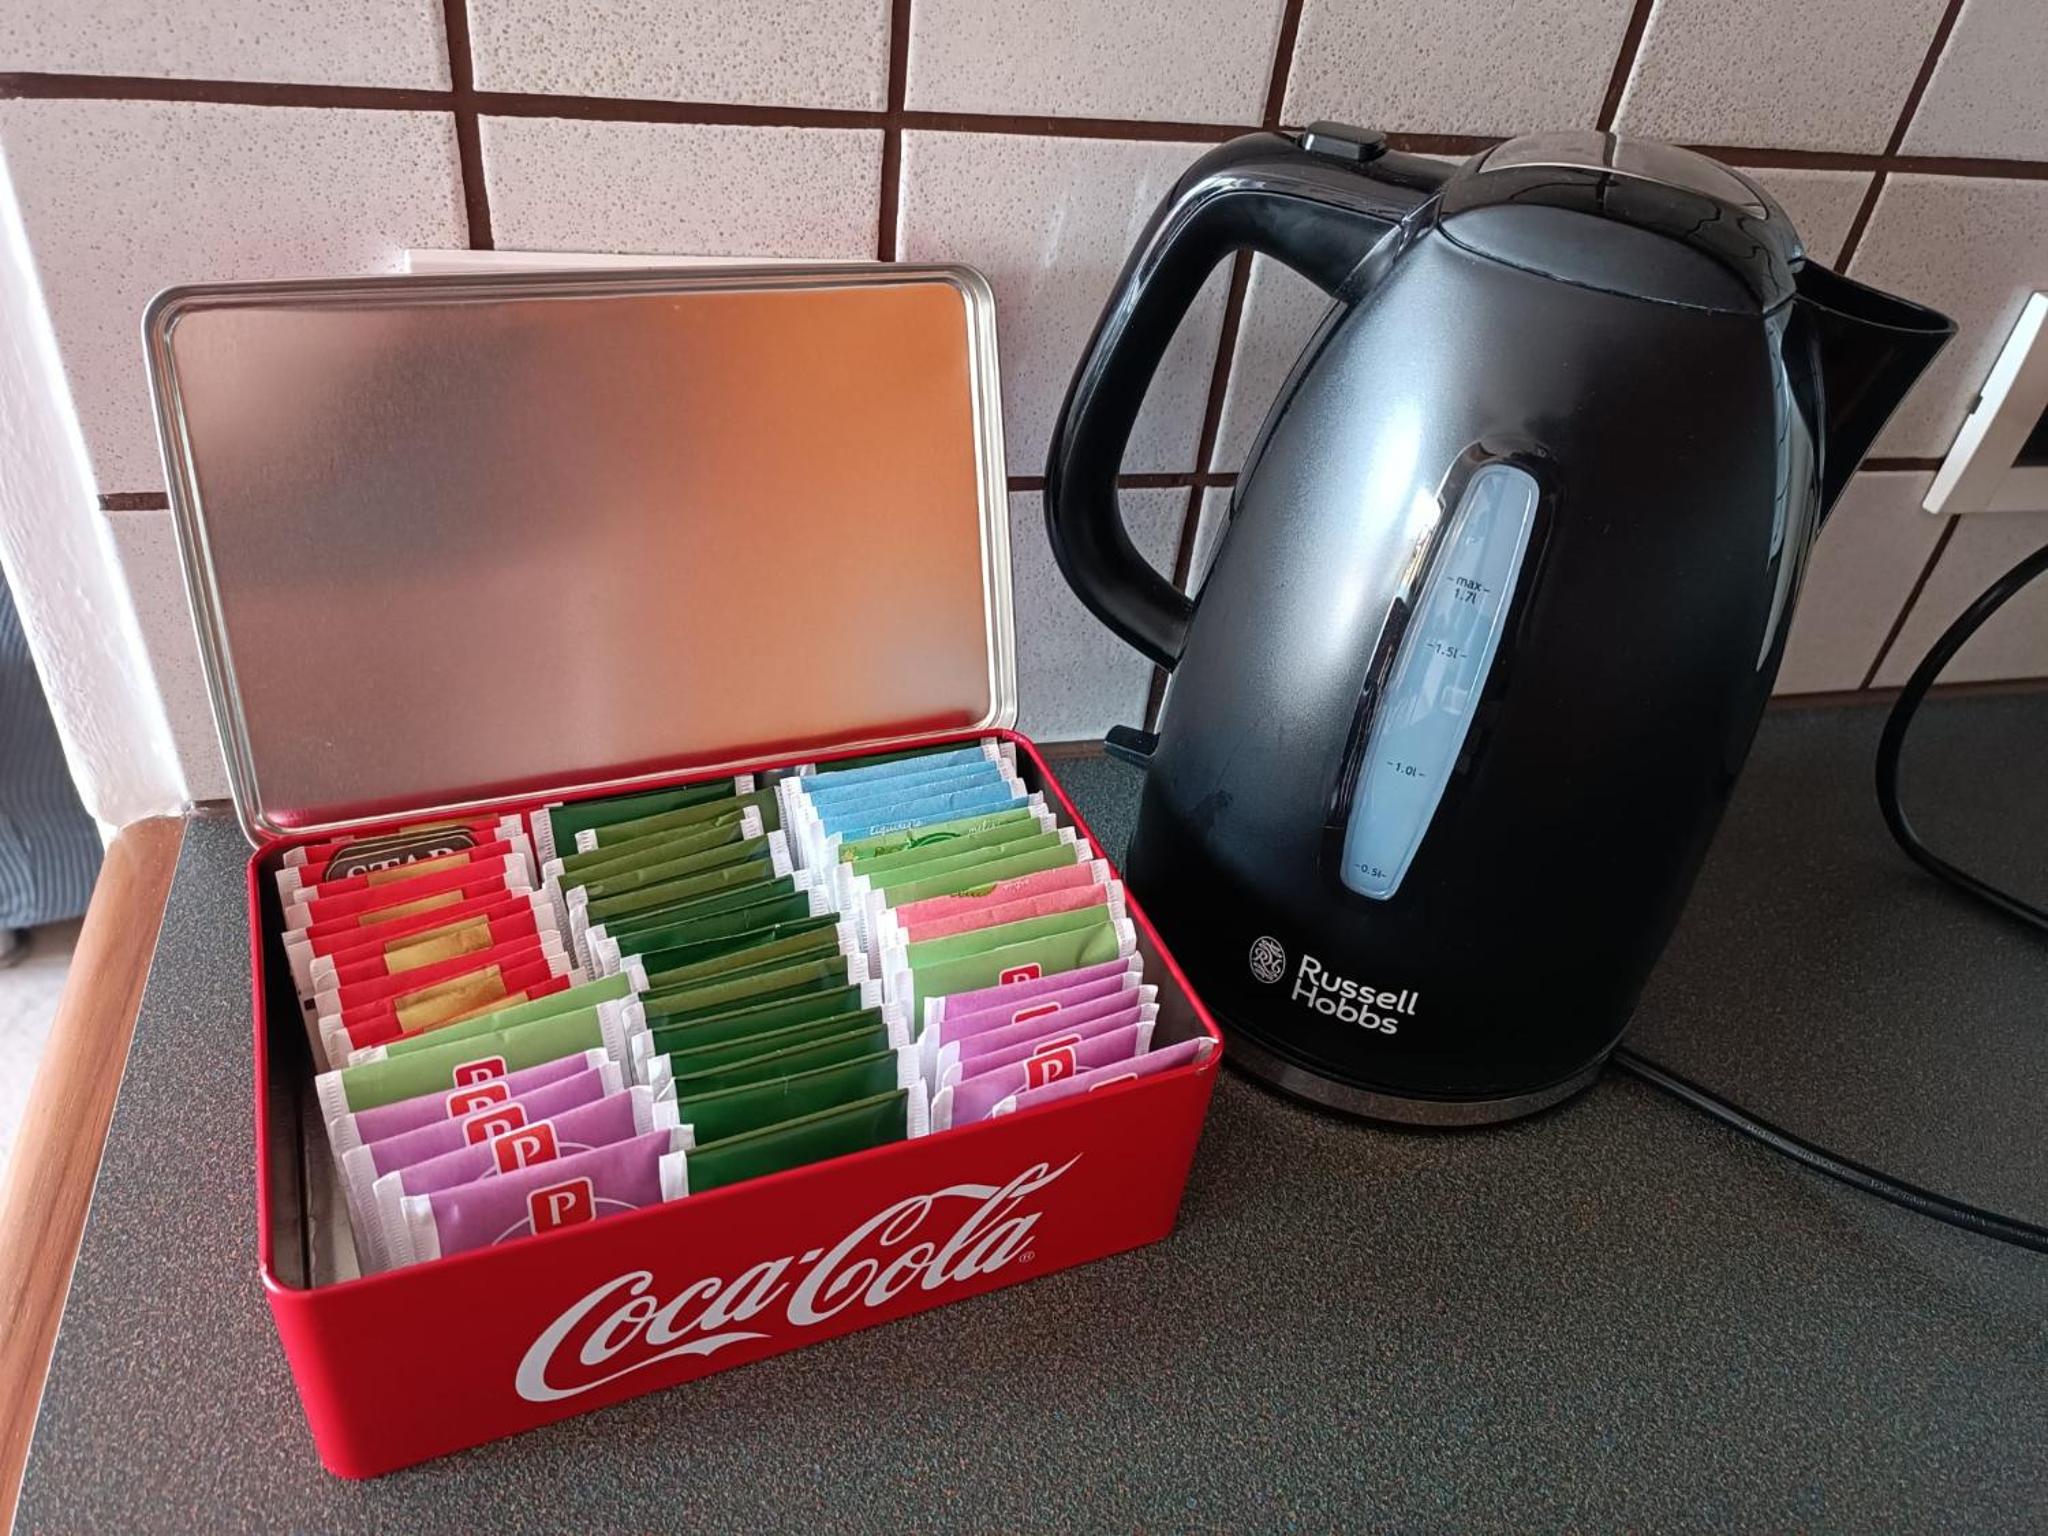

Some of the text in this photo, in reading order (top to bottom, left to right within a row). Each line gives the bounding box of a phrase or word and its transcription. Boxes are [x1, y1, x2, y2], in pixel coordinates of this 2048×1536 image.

[1456, 575, 1482, 592] max
[1298, 954, 1419, 1016] Russell
[1291, 978, 1399, 1034] Hobbs
[1041, 1059, 1064, 1088] P
[512, 1135, 541, 1170] P
[548, 1191, 577, 1226] P
[515, 1152, 1084, 1402] Coca-Cola
